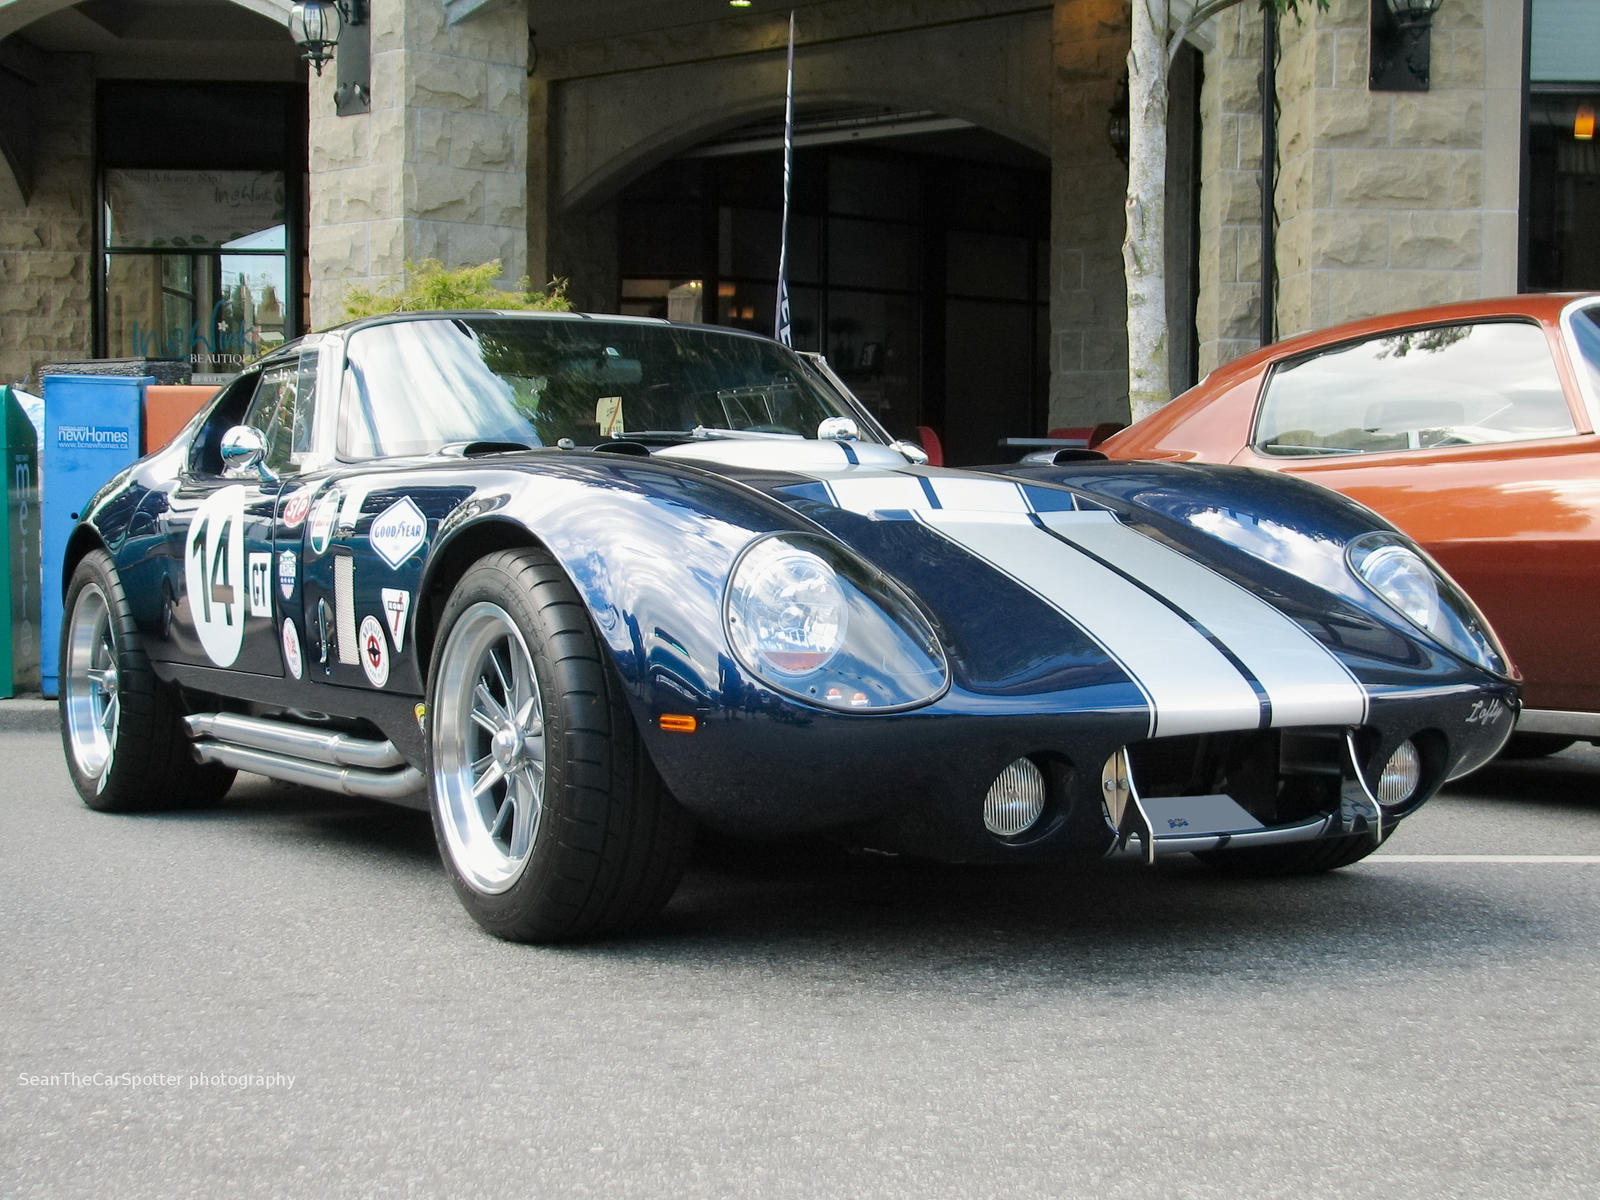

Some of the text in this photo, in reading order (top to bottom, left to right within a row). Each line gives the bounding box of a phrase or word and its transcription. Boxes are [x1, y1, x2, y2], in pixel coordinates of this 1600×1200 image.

[58, 426, 128, 443] newHomes
[287, 497, 308, 519] STP
[193, 514, 235, 626] 14
[252, 562, 268, 607] GT
